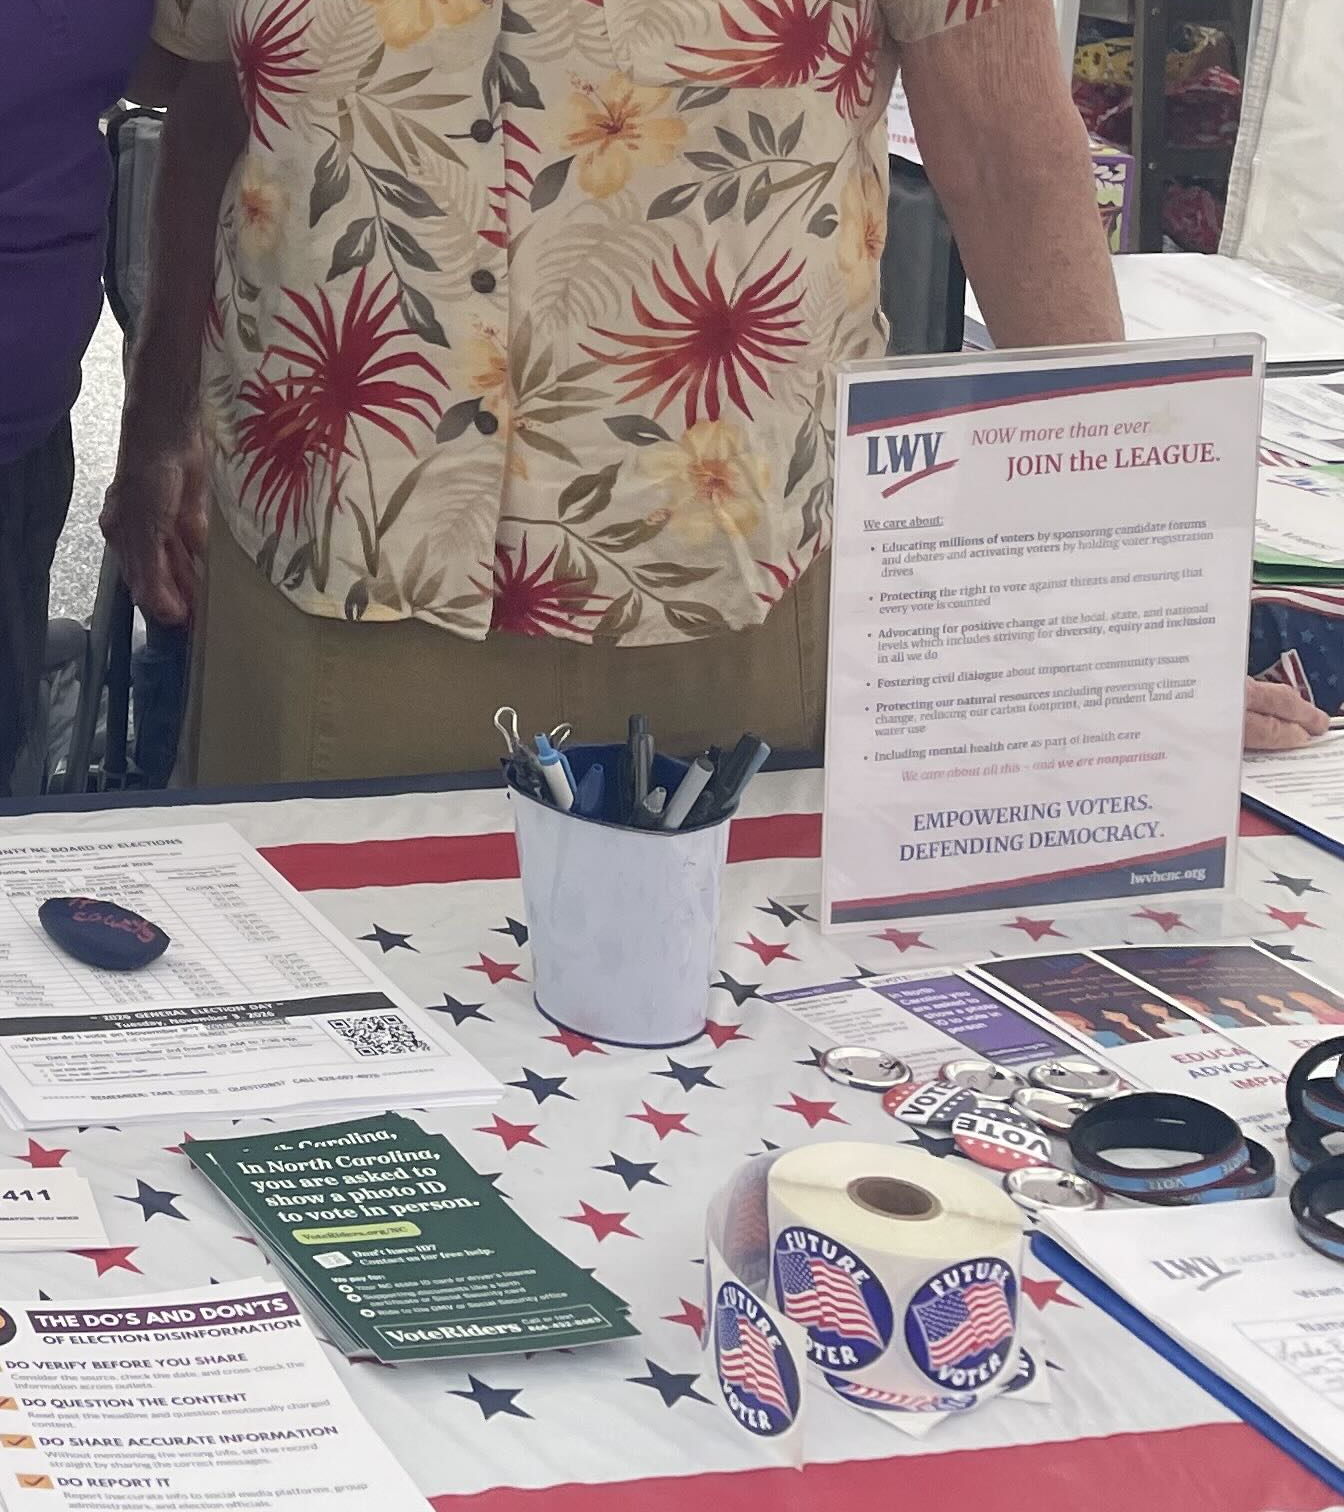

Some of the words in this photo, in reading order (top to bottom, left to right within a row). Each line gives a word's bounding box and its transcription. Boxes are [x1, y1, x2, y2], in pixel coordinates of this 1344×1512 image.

[970, 427, 1017, 447] NOW
[1019, 424, 1065, 442] more
[1067, 420, 1109, 440] than
[865, 430, 946, 477] LWV
[1006, 453, 1063, 482] JOIN
[1069, 449, 1108, 472] the
[1113, 442, 1222, 470] LEAGUE.
[912, 800, 1062, 832] EMPOWERING
[1065, 793, 1154, 818] VOTERS.
[899, 831, 1025, 863] DEFENDING
[1027, 820, 1165, 851] DEMOCRACY.
[901, 1080, 958, 1117] VOTE
[955, 1116, 1050, 1157] VOTE
[236, 1161, 267, 1175] In
[267, 1156, 333, 1174] North
[334, 1148, 442, 1169] Carolina,
[2, 1188, 52, 1202] 411
[250, 1179, 298, 1194] you
[301, 1175, 340, 1188] are
[342, 1167, 410, 1187] asked
[411, 1166, 438, 1178] to
[265, 1192, 326, 1207] show
[329, 1192, 347, 1203] a
[348, 1186, 417, 1206] photo
[420, 1180, 448, 1195] ID
[276, 1210, 304, 1224] to
[305, 1206, 359, 1222] vote
[360, 1203, 389, 1218] in
[389, 1195, 481, 1218] person.
[784, 1230, 872, 1288] FUTURE
[929, 1261, 1011, 1298] FUTURE
[34, 1313, 80, 1329] THE
[82, 1311, 142, 1328] DO'S
[145, 1305, 197, 1326] AND
[199, 1297, 290, 1321] DON'TS
[721, 1286, 782, 1351] FUTURE
[41, 1334, 68, 1345] OF
[70, 1331, 151, 1345] ELECTION
[153, 1318, 302, 1343] DISINFORMATION
[384, 1321, 522, 1345] VoteRiders
[5, 1359, 30, 1370] DO
[31, 1359, 88, 1371] VERIFY
[91, 1358, 152, 1370] BEFORE
[154, 1356, 192, 1368] YOU
[195, 1352, 249, 1367] SHARE
[806, 1336, 860, 1365] OTER
[936, 1353, 1002, 1388] VOTER
[20, 1397, 46, 1408] DO
[50, 1396, 136, 1409] QUESTION
[138, 1396, 167, 1408] THE
[170, 1392, 248, 1406] CONTENT
